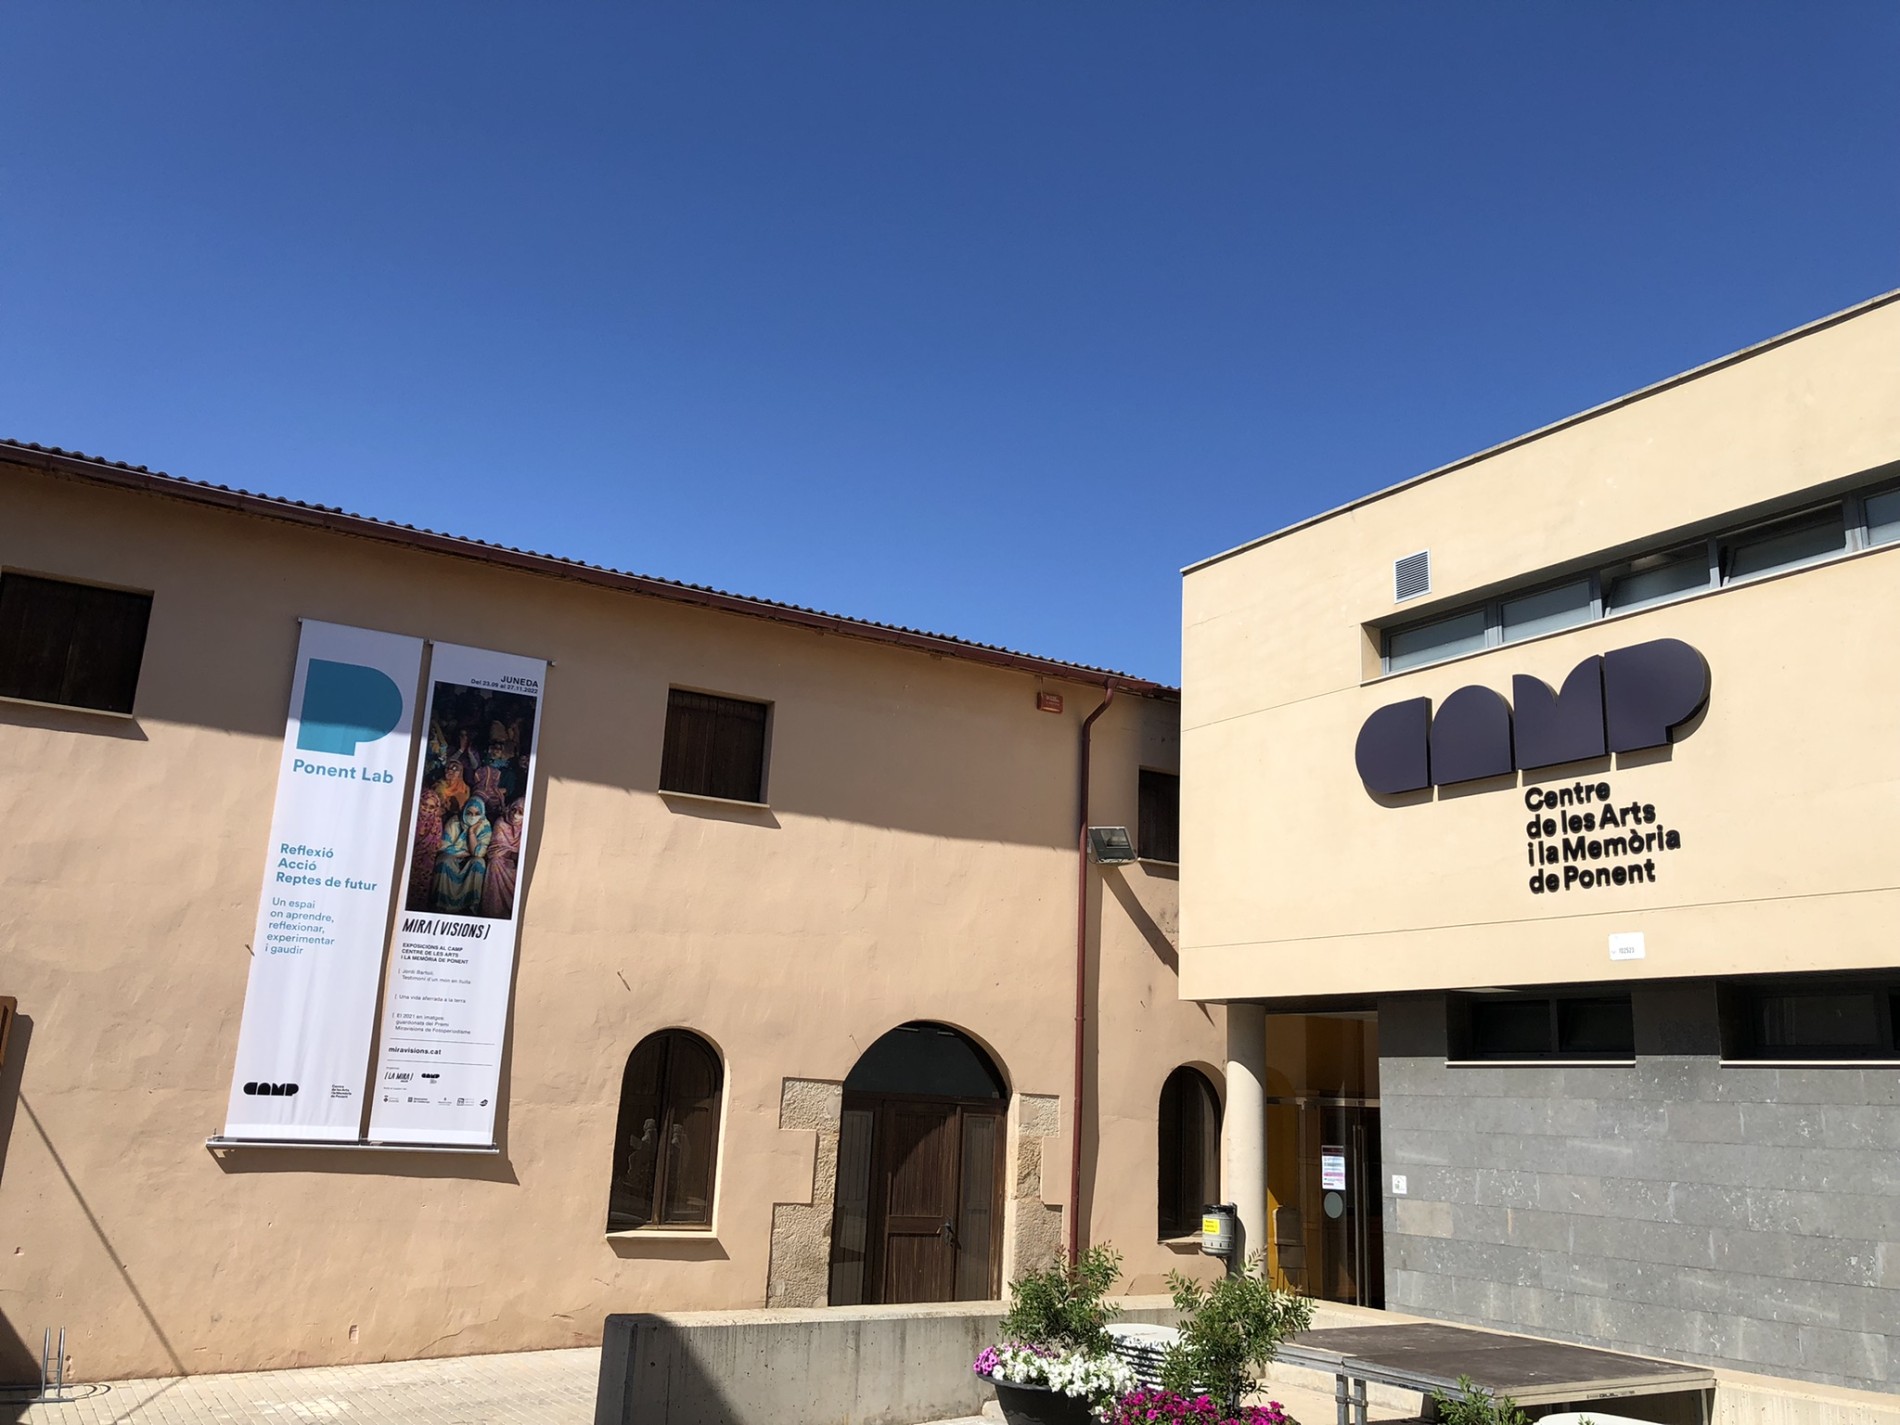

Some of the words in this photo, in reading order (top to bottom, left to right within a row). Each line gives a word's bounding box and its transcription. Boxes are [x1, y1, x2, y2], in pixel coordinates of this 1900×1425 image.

[482, 680, 499, 688] 23.09
[507, 684, 539, 694] 27.11.2022
[500, 675, 539, 688] JUNEDA
[292, 758, 357, 779] Ponent
[361, 767, 394, 784] Lab
[1525, 782, 1611, 812] Centre
[1526, 813, 1557, 840] de
[1560, 809, 1596, 835] les
[1599, 801, 1656, 830] Arts
[280, 843, 334, 859] Reflexió
[1527, 841, 1535, 867] i
[1538, 840, 1560, 866] la
[1562, 824, 1682, 863] Memòria
[277, 857, 317, 871] Acció
[276, 871, 322, 886] Reptes
[324, 876, 341, 888] de
[344, 877, 378, 891] futur
[1529, 868, 1561, 895] de
[1563, 858, 1656, 892] Ponent
[272, 897, 286, 907] Un
[288, 900, 316, 910] espai
[270, 910, 283, 918] on
[285, 911, 335, 924] aprendre,
[268, 921, 325, 934] reflexionar,
[402, 918, 432, 934] MIRA
[266, 933, 335, 945] experimentar
[402, 942, 438, 950] EXPOSICIONS
[270, 944, 304, 955] gaudir
[412, 955, 437, 963] MEMÒRIA
[388, 1046, 442, 1055] miravisions.cat
